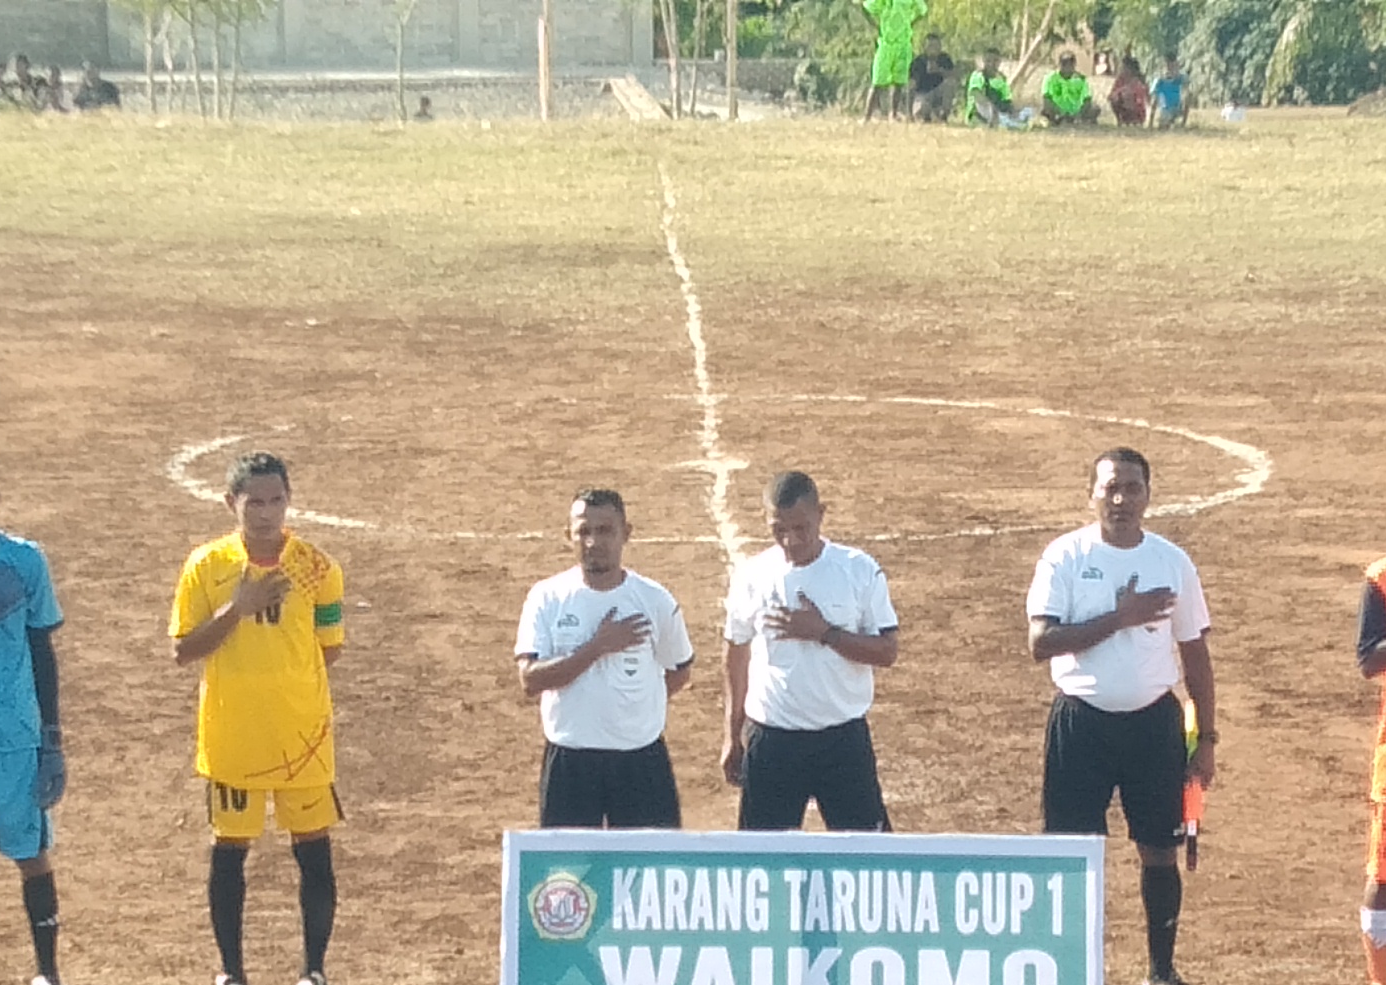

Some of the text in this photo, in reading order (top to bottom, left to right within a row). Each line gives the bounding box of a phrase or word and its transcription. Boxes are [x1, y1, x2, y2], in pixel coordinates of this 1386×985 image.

[215, 781, 247, 812] 10
[612, 866, 1064, 937] KARANG TARUNA CUP 1
